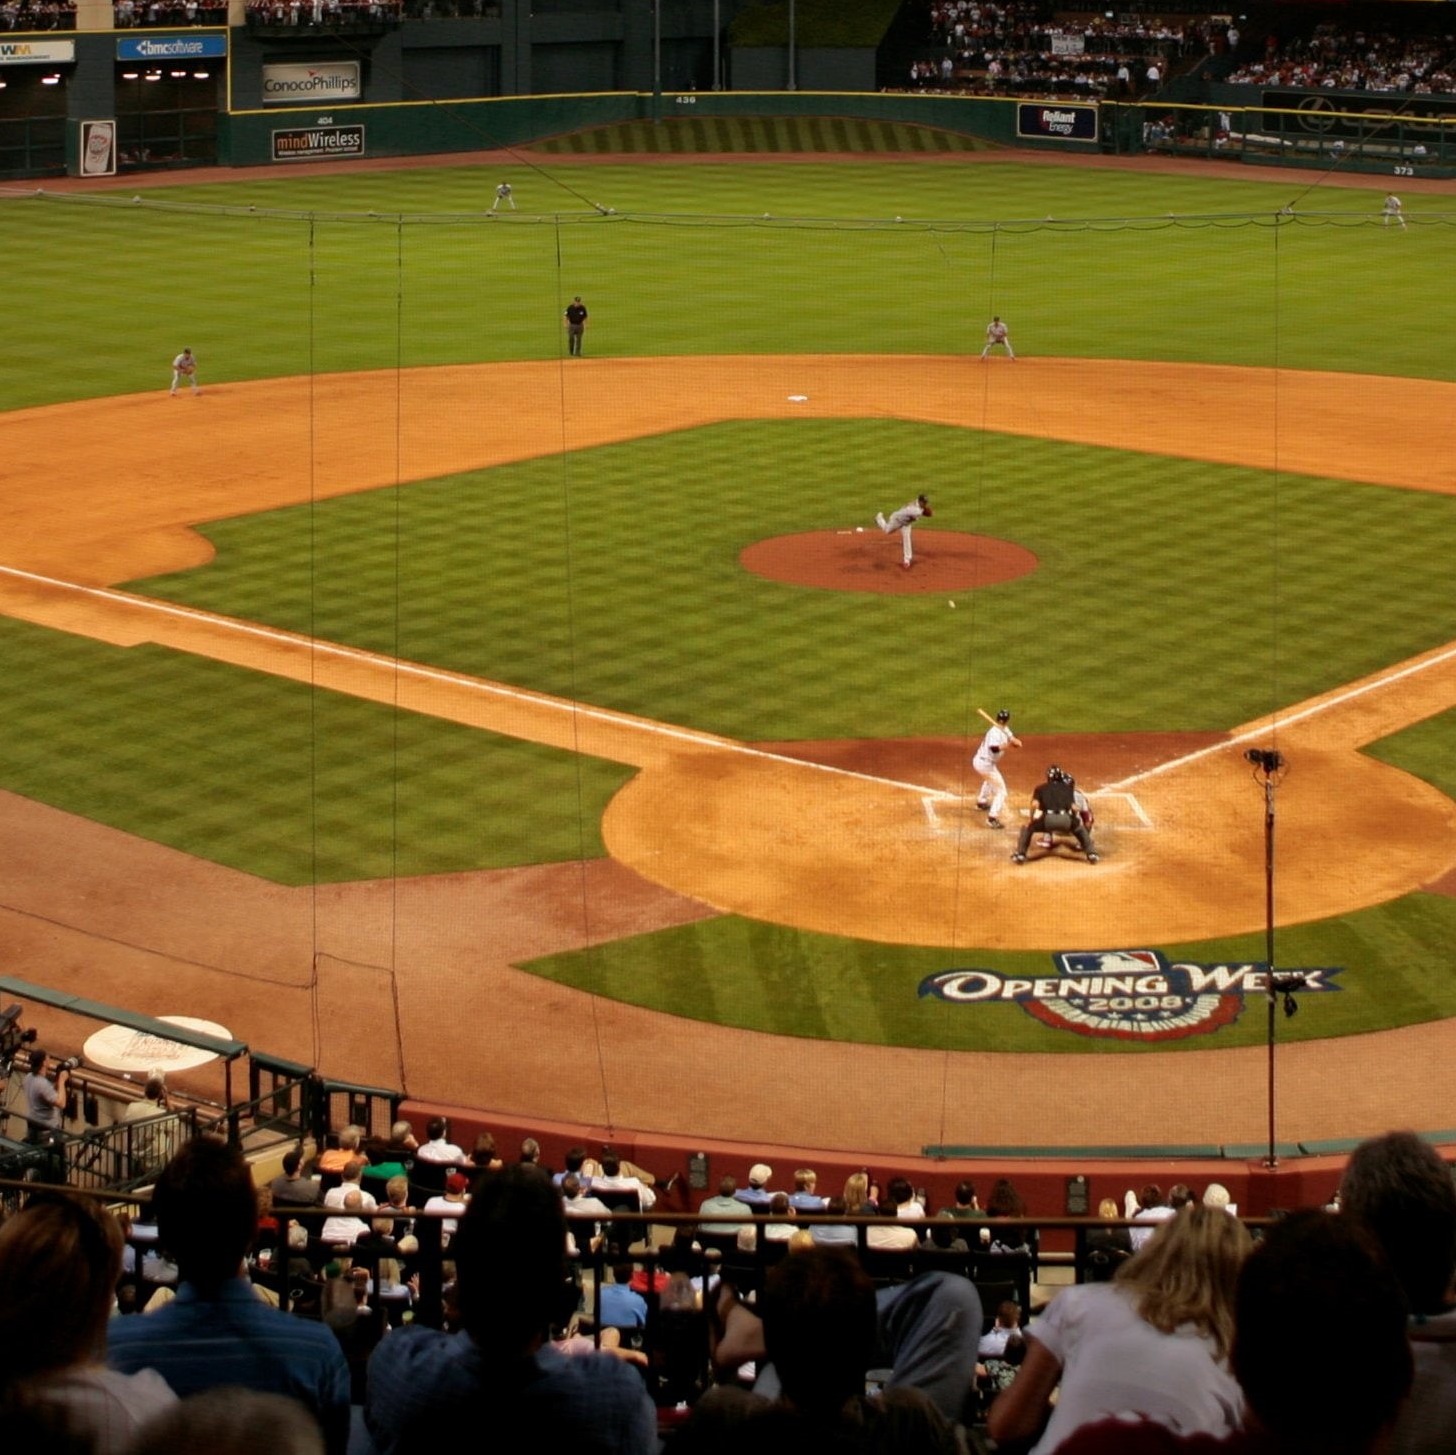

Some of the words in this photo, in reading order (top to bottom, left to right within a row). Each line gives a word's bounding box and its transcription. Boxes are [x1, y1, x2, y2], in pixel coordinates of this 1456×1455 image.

[264, 74, 357, 93] ConocoPhillips
[316, 116, 334, 125] 404
[1042, 110, 1076, 123] Reliant
[1048, 122, 1074, 135] Energy
[276, 130, 361, 150] mindWireless
[1393, 165, 1413, 175] 373
[933, 969, 1168, 1002] OPENING
[1171, 963, 1323, 992] WEK
[1088, 994, 1185, 1012] 2008
